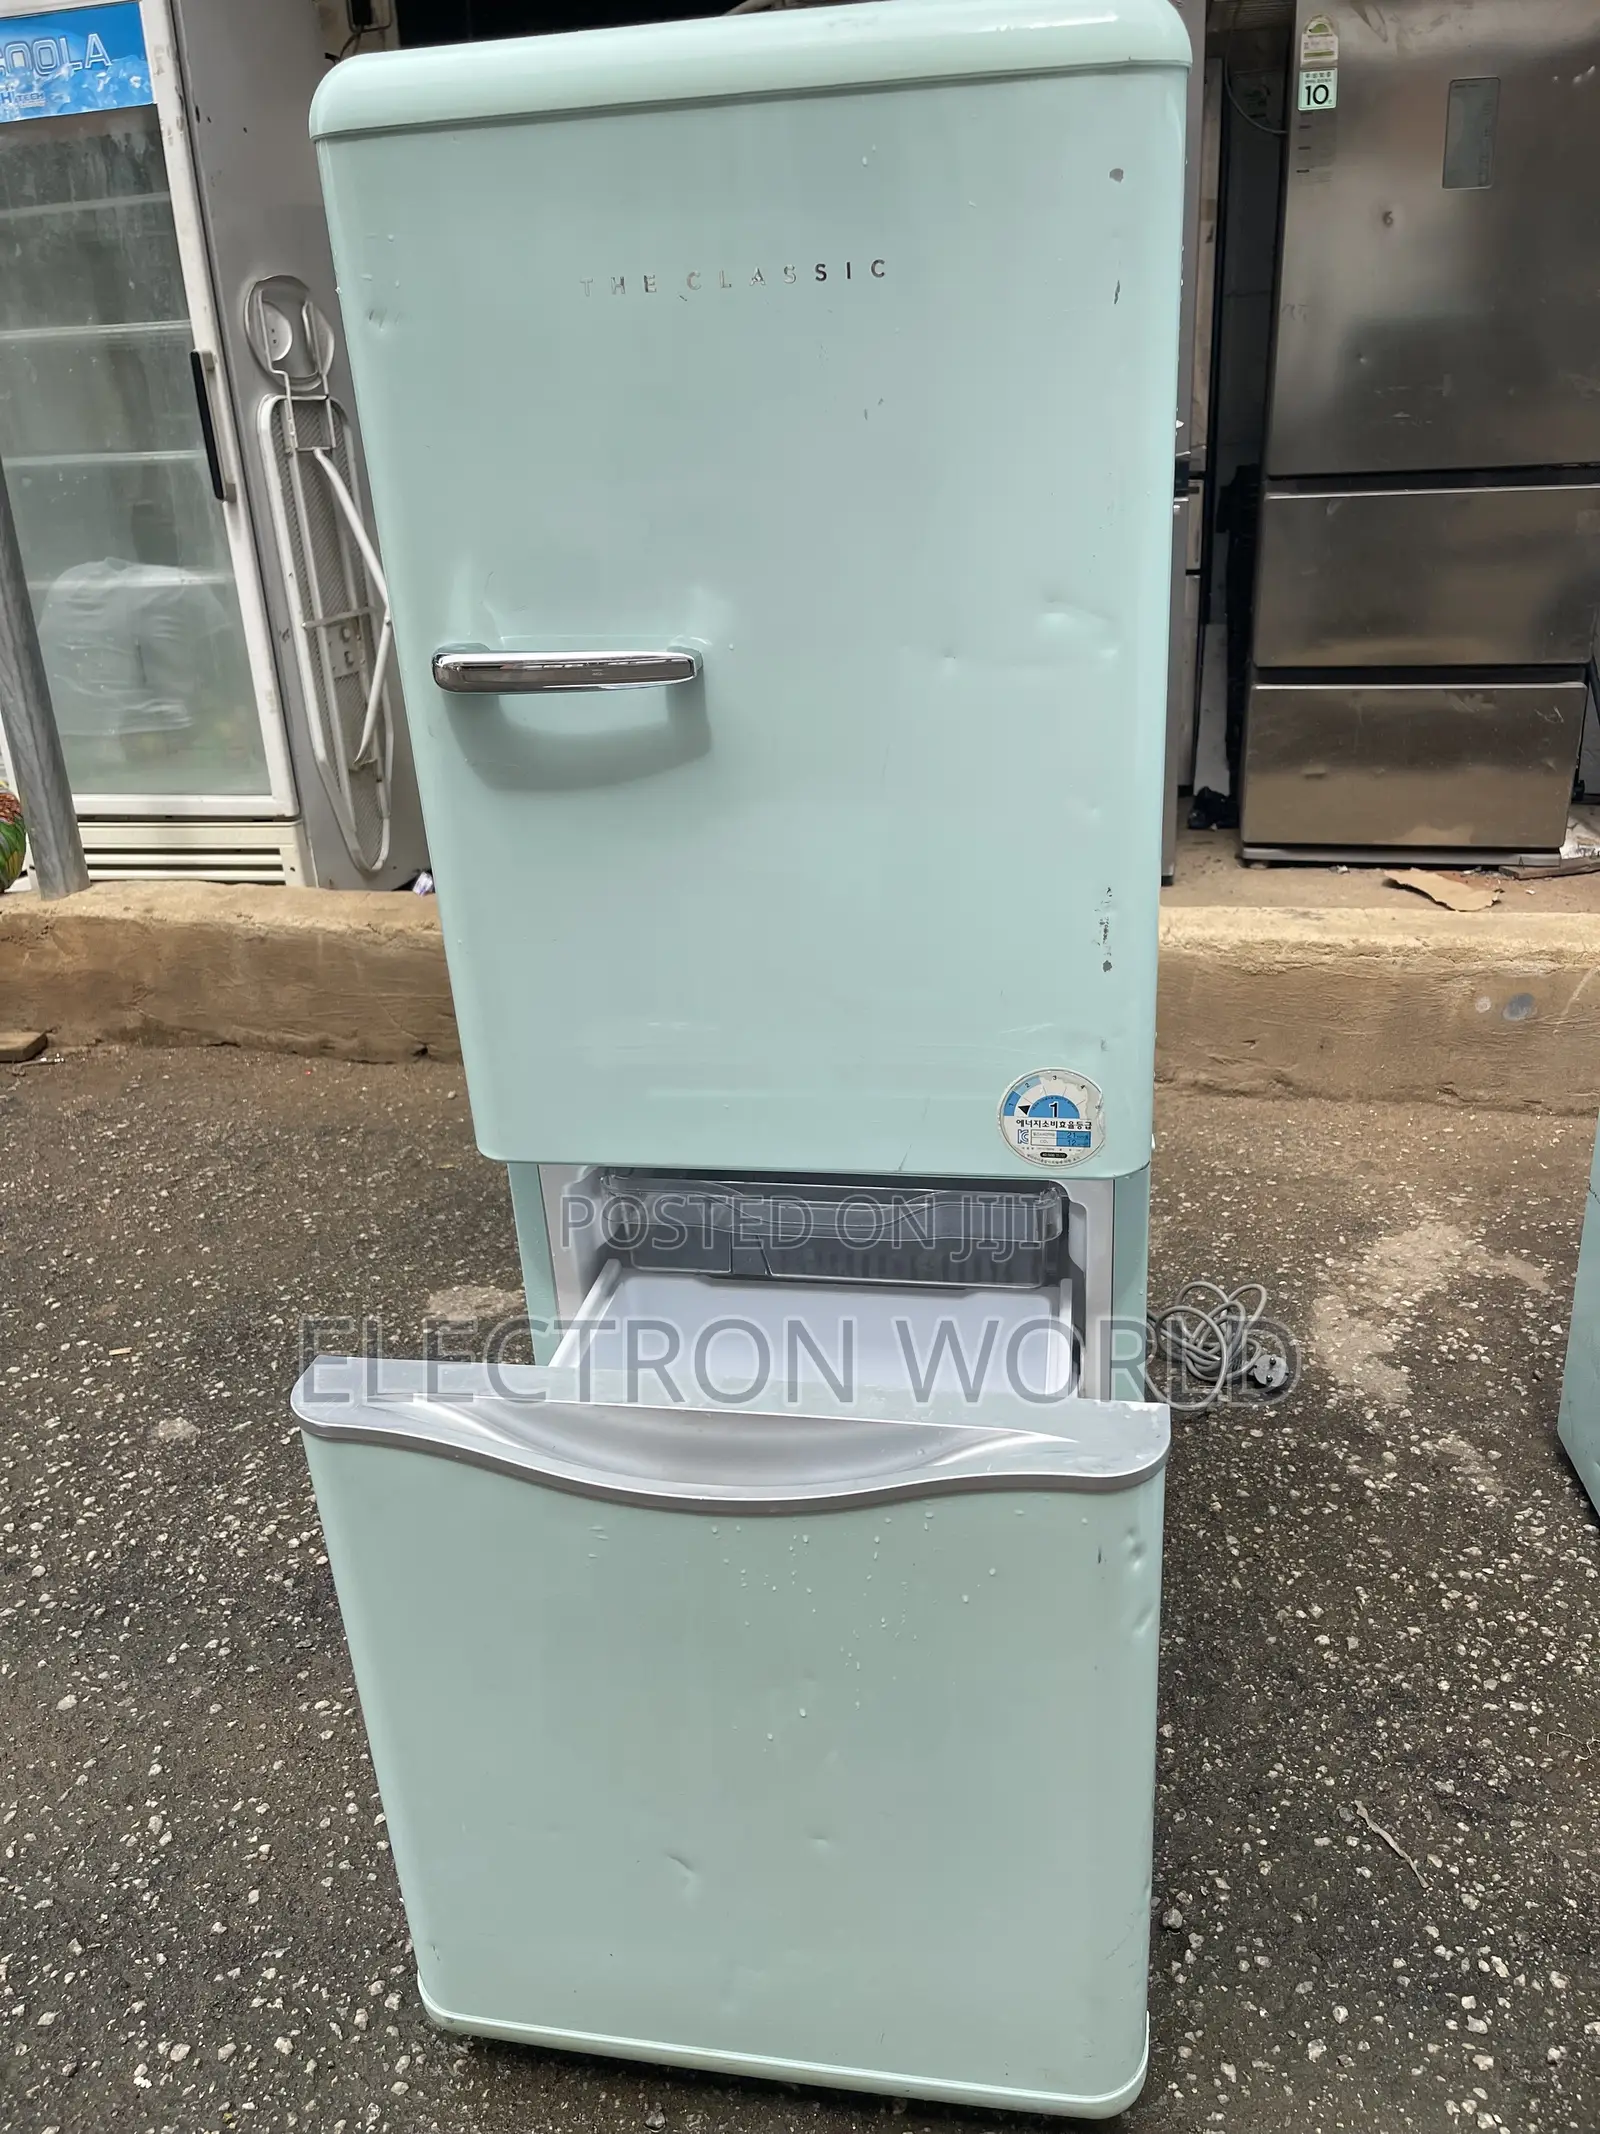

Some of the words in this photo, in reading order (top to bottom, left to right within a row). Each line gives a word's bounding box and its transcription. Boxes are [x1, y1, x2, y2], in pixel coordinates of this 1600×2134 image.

[0, 33, 112, 76] OOLA
[580, 274, 656, 296] THE
[687, 258, 885, 290] CLASSIC
[1049, 1102, 1059, 1117] 1
[1016, 1119, 1092, 1130] 에너지소비효율등급
